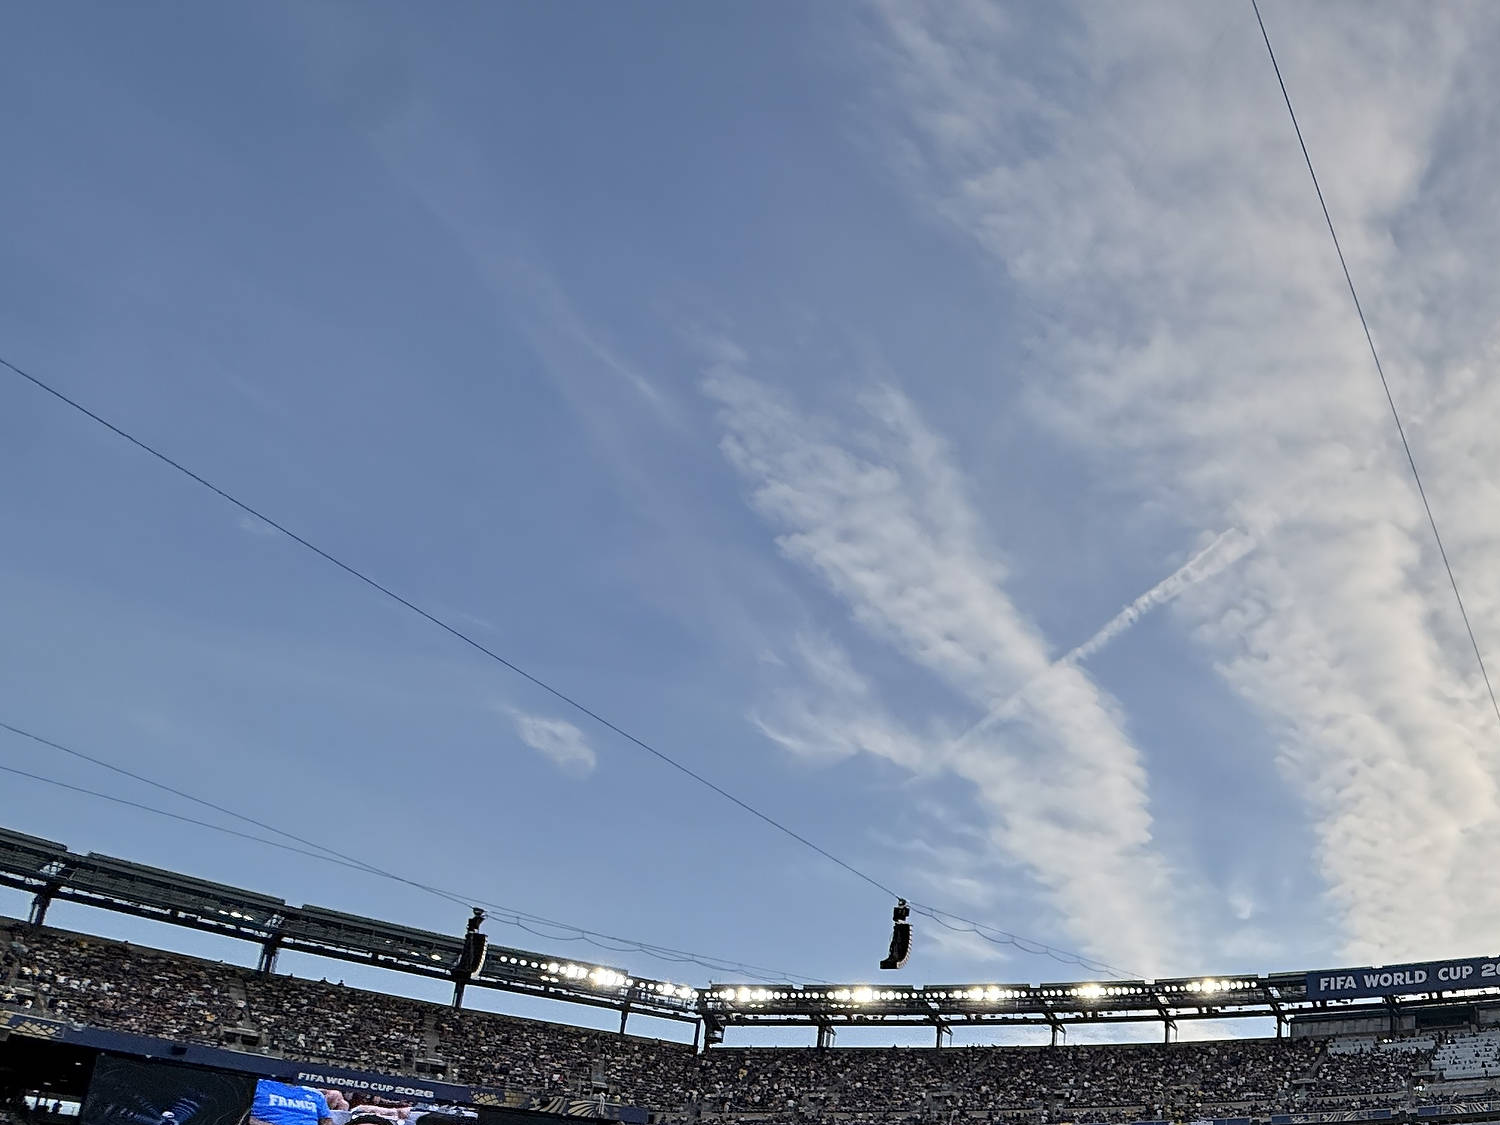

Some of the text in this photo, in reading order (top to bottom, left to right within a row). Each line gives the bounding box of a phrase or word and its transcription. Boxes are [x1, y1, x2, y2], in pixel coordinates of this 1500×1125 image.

[1319, 976, 1357, 991] FIFA
[1363, 970, 1427, 988] WORLD
[1438, 966, 1473, 981] CUP
[298, 1072, 434, 1098] FIFA WORLD CUP 2026
